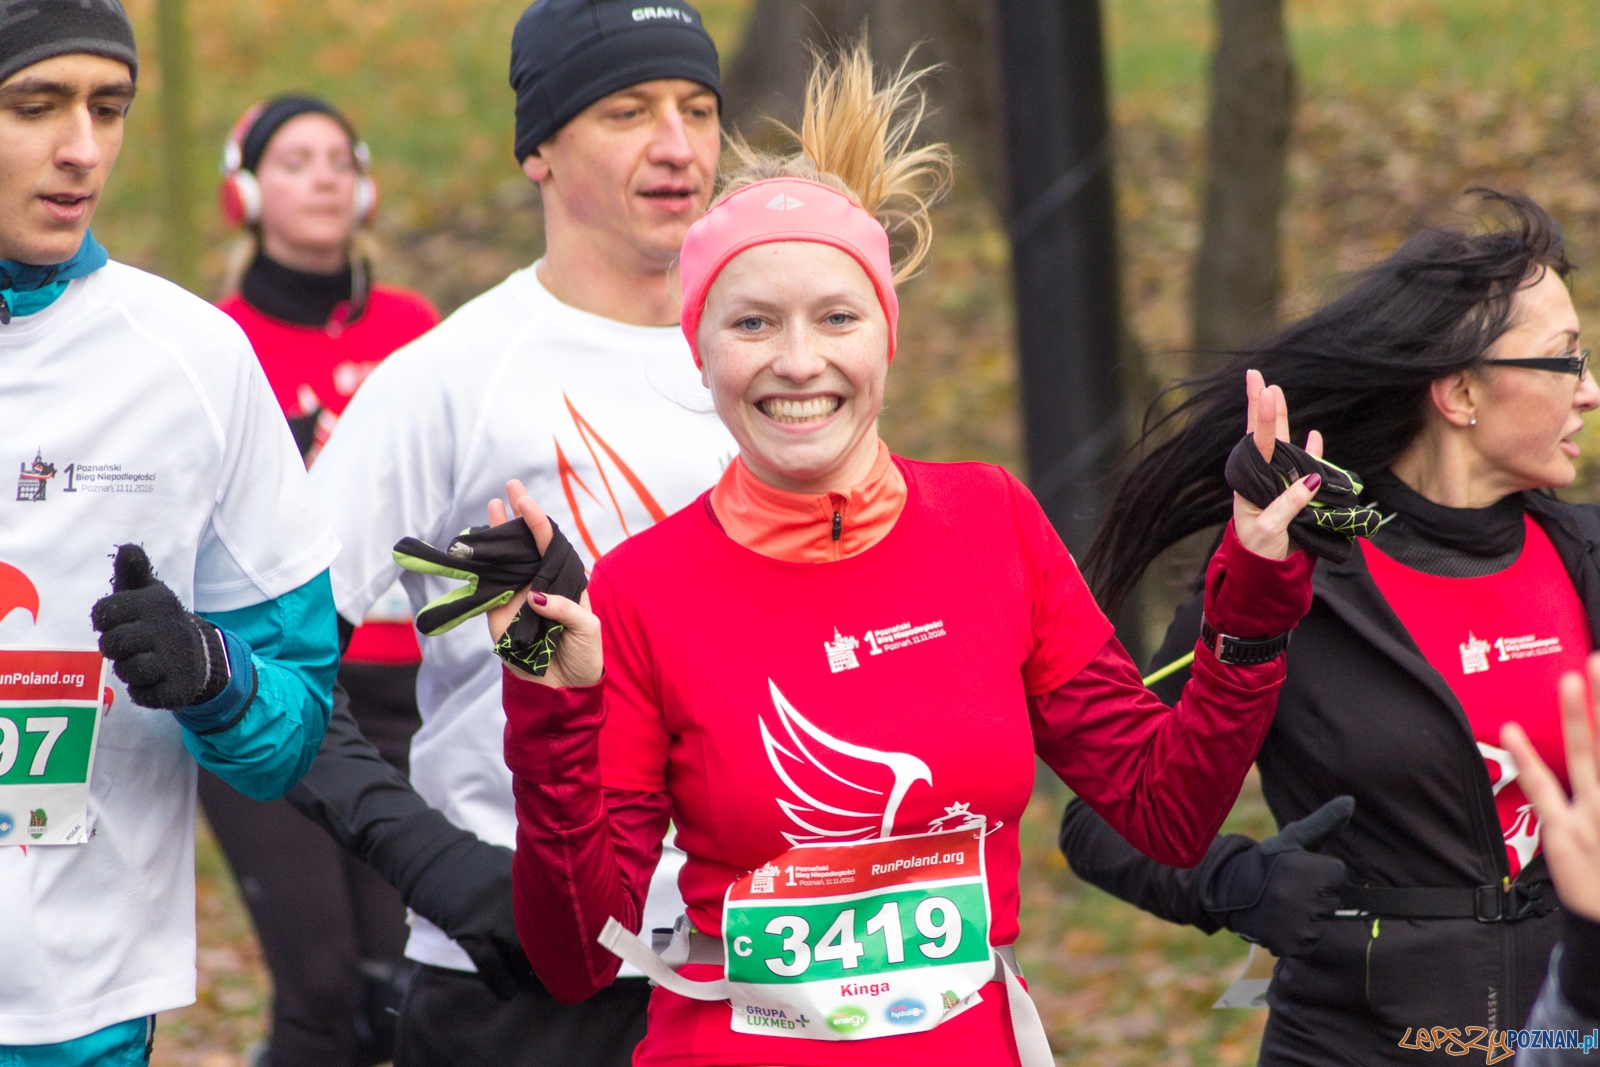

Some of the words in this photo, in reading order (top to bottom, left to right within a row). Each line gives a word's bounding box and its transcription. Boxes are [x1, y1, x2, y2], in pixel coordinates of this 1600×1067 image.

[76, 463, 121, 471] Poznański
[63, 463, 77, 492] 1
[76, 473, 95, 481] Bieg
[97, 473, 156, 481] Niepodległości
[874, 622, 911, 636] Poznański
[876, 634, 894, 645] Bieg
[893, 620, 943, 639] Niepodległości
[863, 630, 883, 656] 1
[1494, 636, 1510, 661] 1
[65, 823, 81, 842] ROGAL
[871, 852, 965, 876] RunPoland.org
[784, 865, 797, 886] 1
[764, 896, 963, 977] 3419
[840, 982, 891, 997] Kinga
[746, 1005, 787, 1019] GRUPA
[833, 1015, 865, 1026] energy
[747, 1014, 796, 1030] LUXMED
